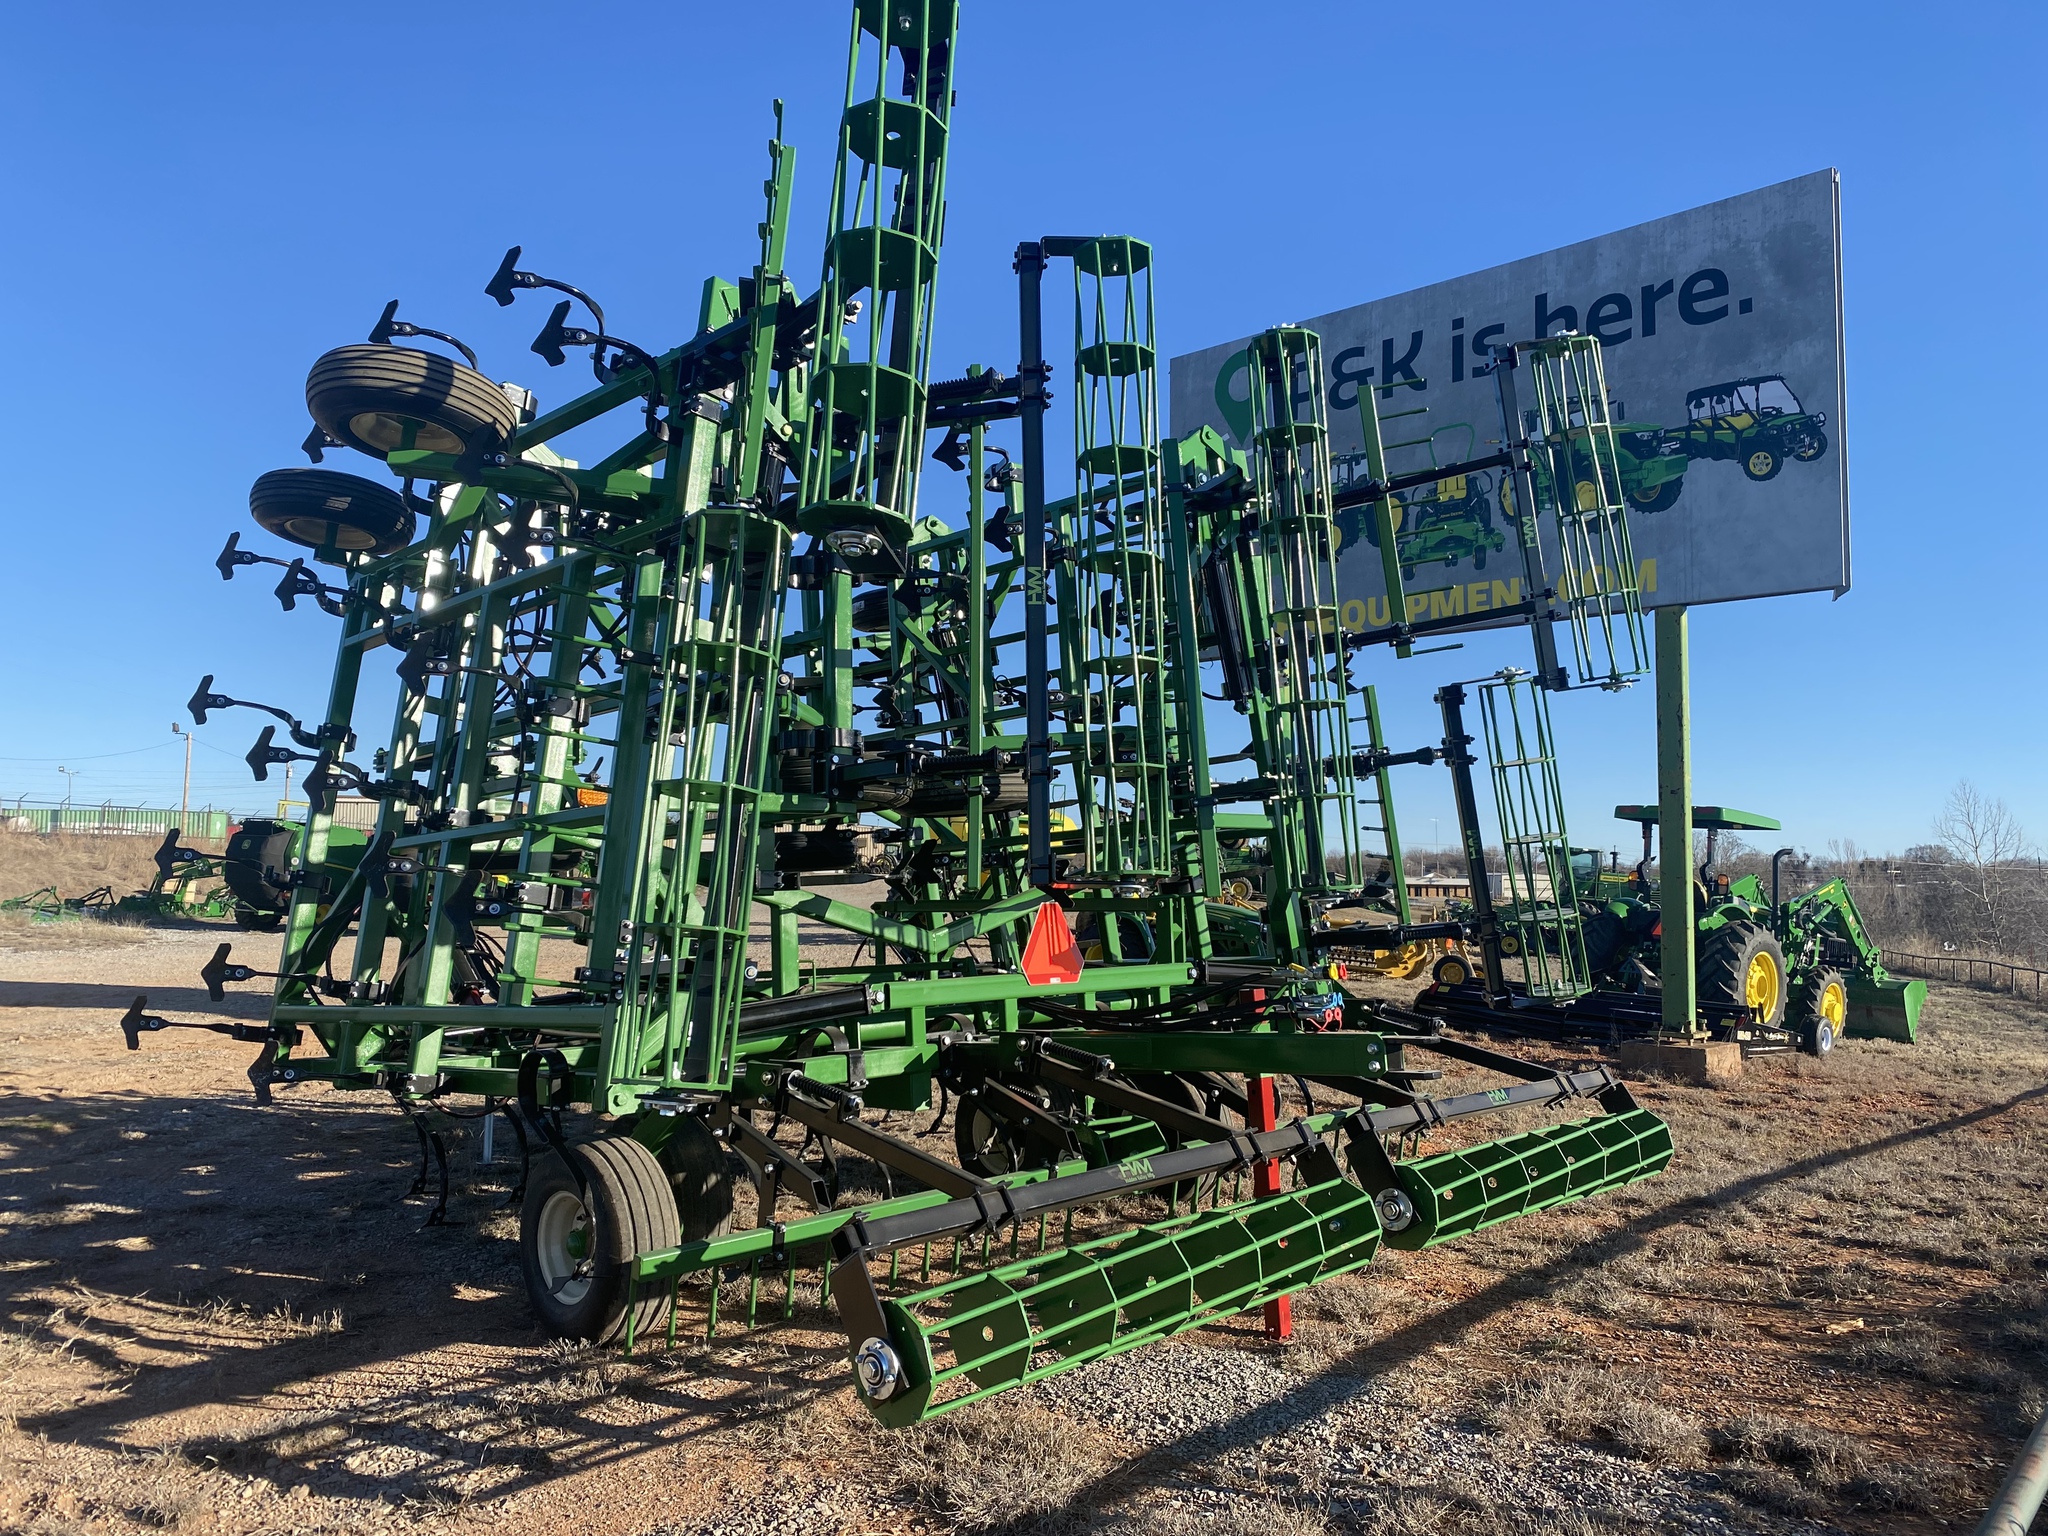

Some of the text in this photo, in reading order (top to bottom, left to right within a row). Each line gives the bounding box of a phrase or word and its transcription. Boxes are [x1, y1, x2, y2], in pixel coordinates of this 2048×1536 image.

[1287, 267, 1753, 421] P&K is here.
[1276, 558, 1658, 637] EQUPMEN.COM
